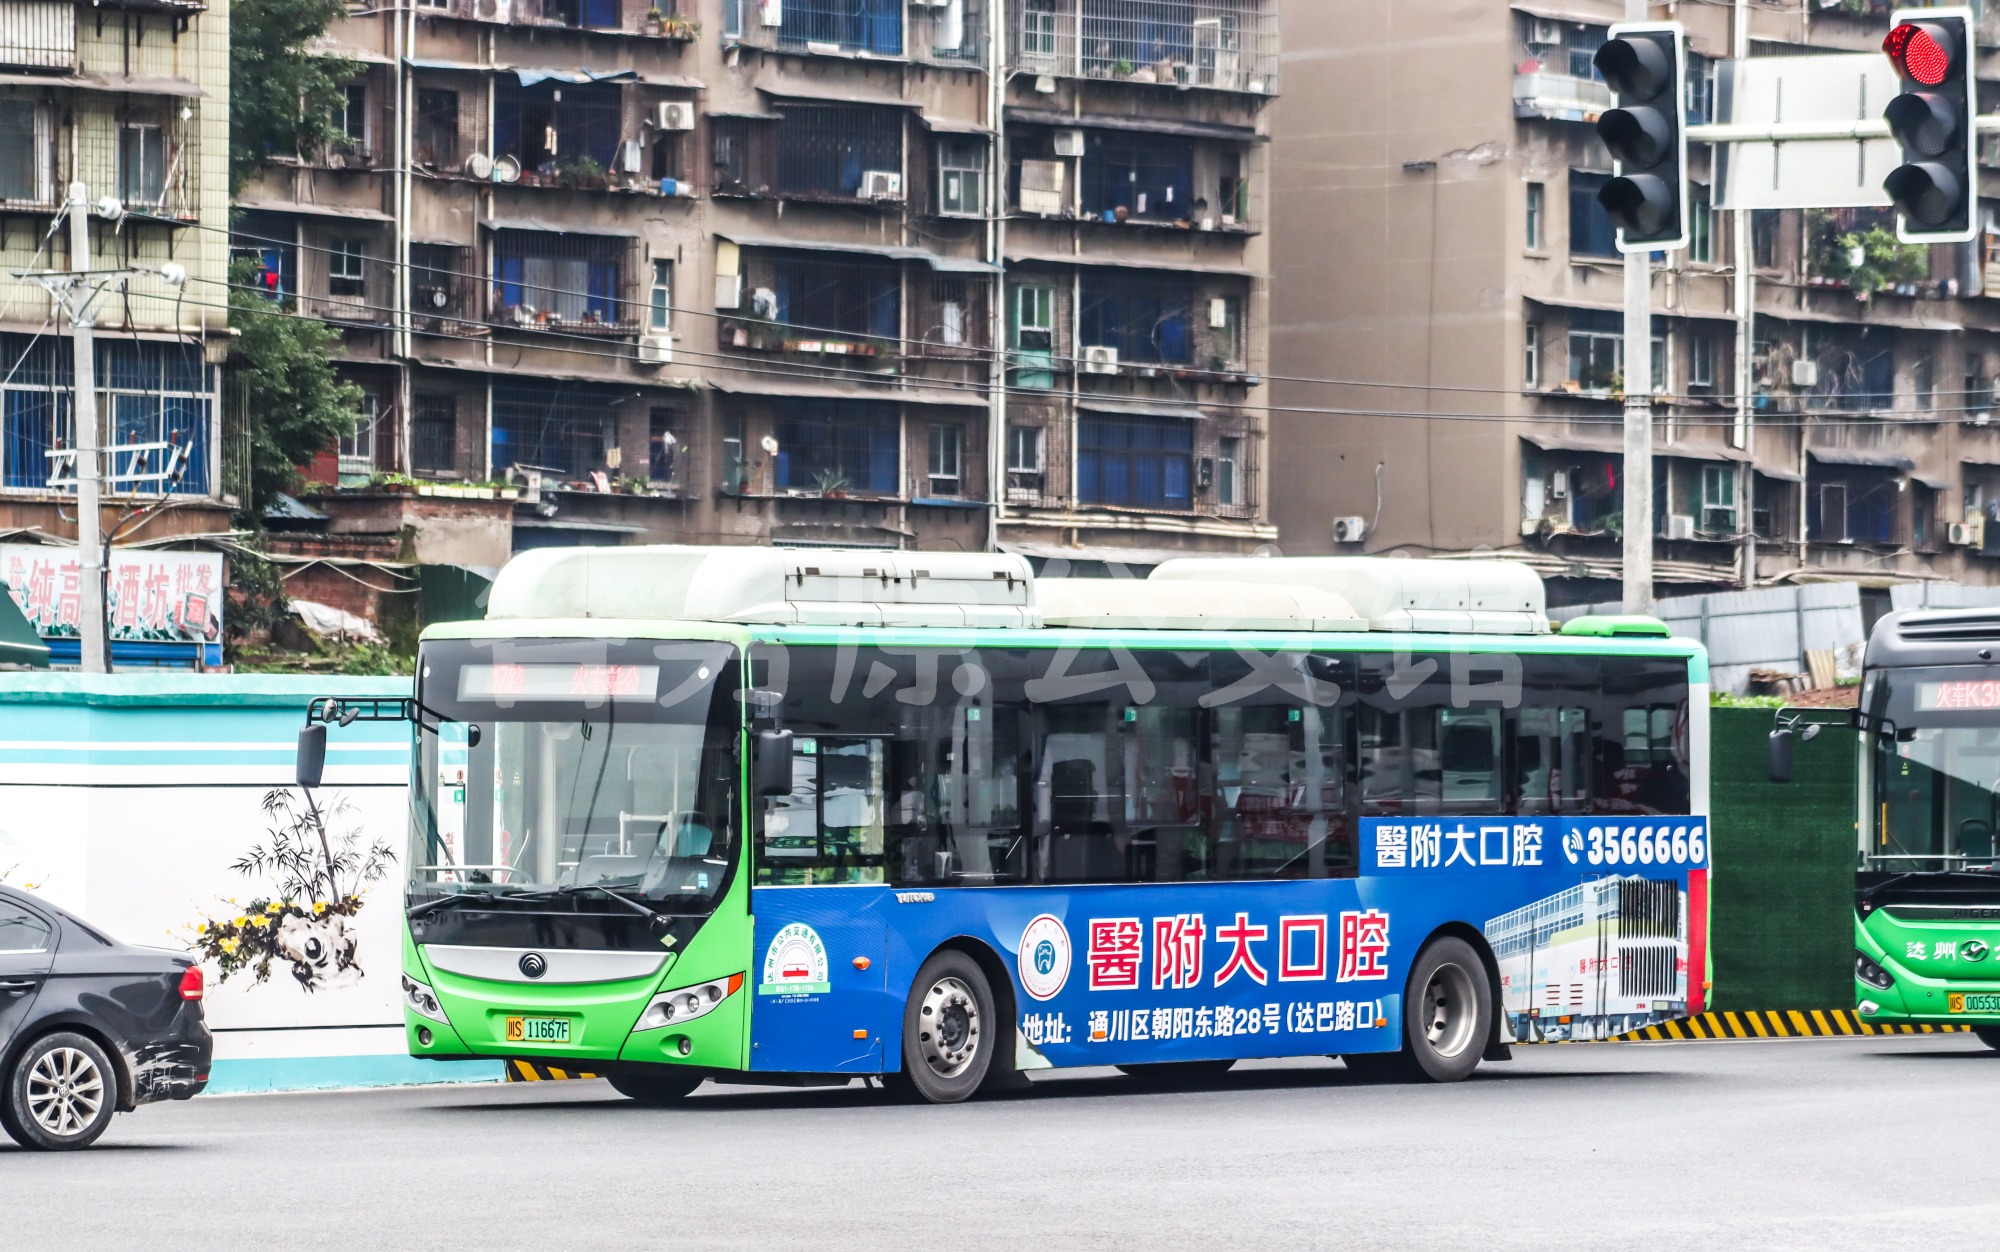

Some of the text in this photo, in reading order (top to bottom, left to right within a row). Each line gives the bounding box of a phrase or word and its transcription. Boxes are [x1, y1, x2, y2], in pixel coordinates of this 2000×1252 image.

[27, 559, 170, 630] 纯高酒坊
[176, 563, 212, 593] 批发
[1375, 823, 1544, 868] 醫附大口腔
[1586, 825, 1705, 866] 3566666
[1087, 912, 1390, 992] 醫附大口腔
[1905, 941, 1957, 960] 达州
[528, 1021, 569, 1039] 11667F
